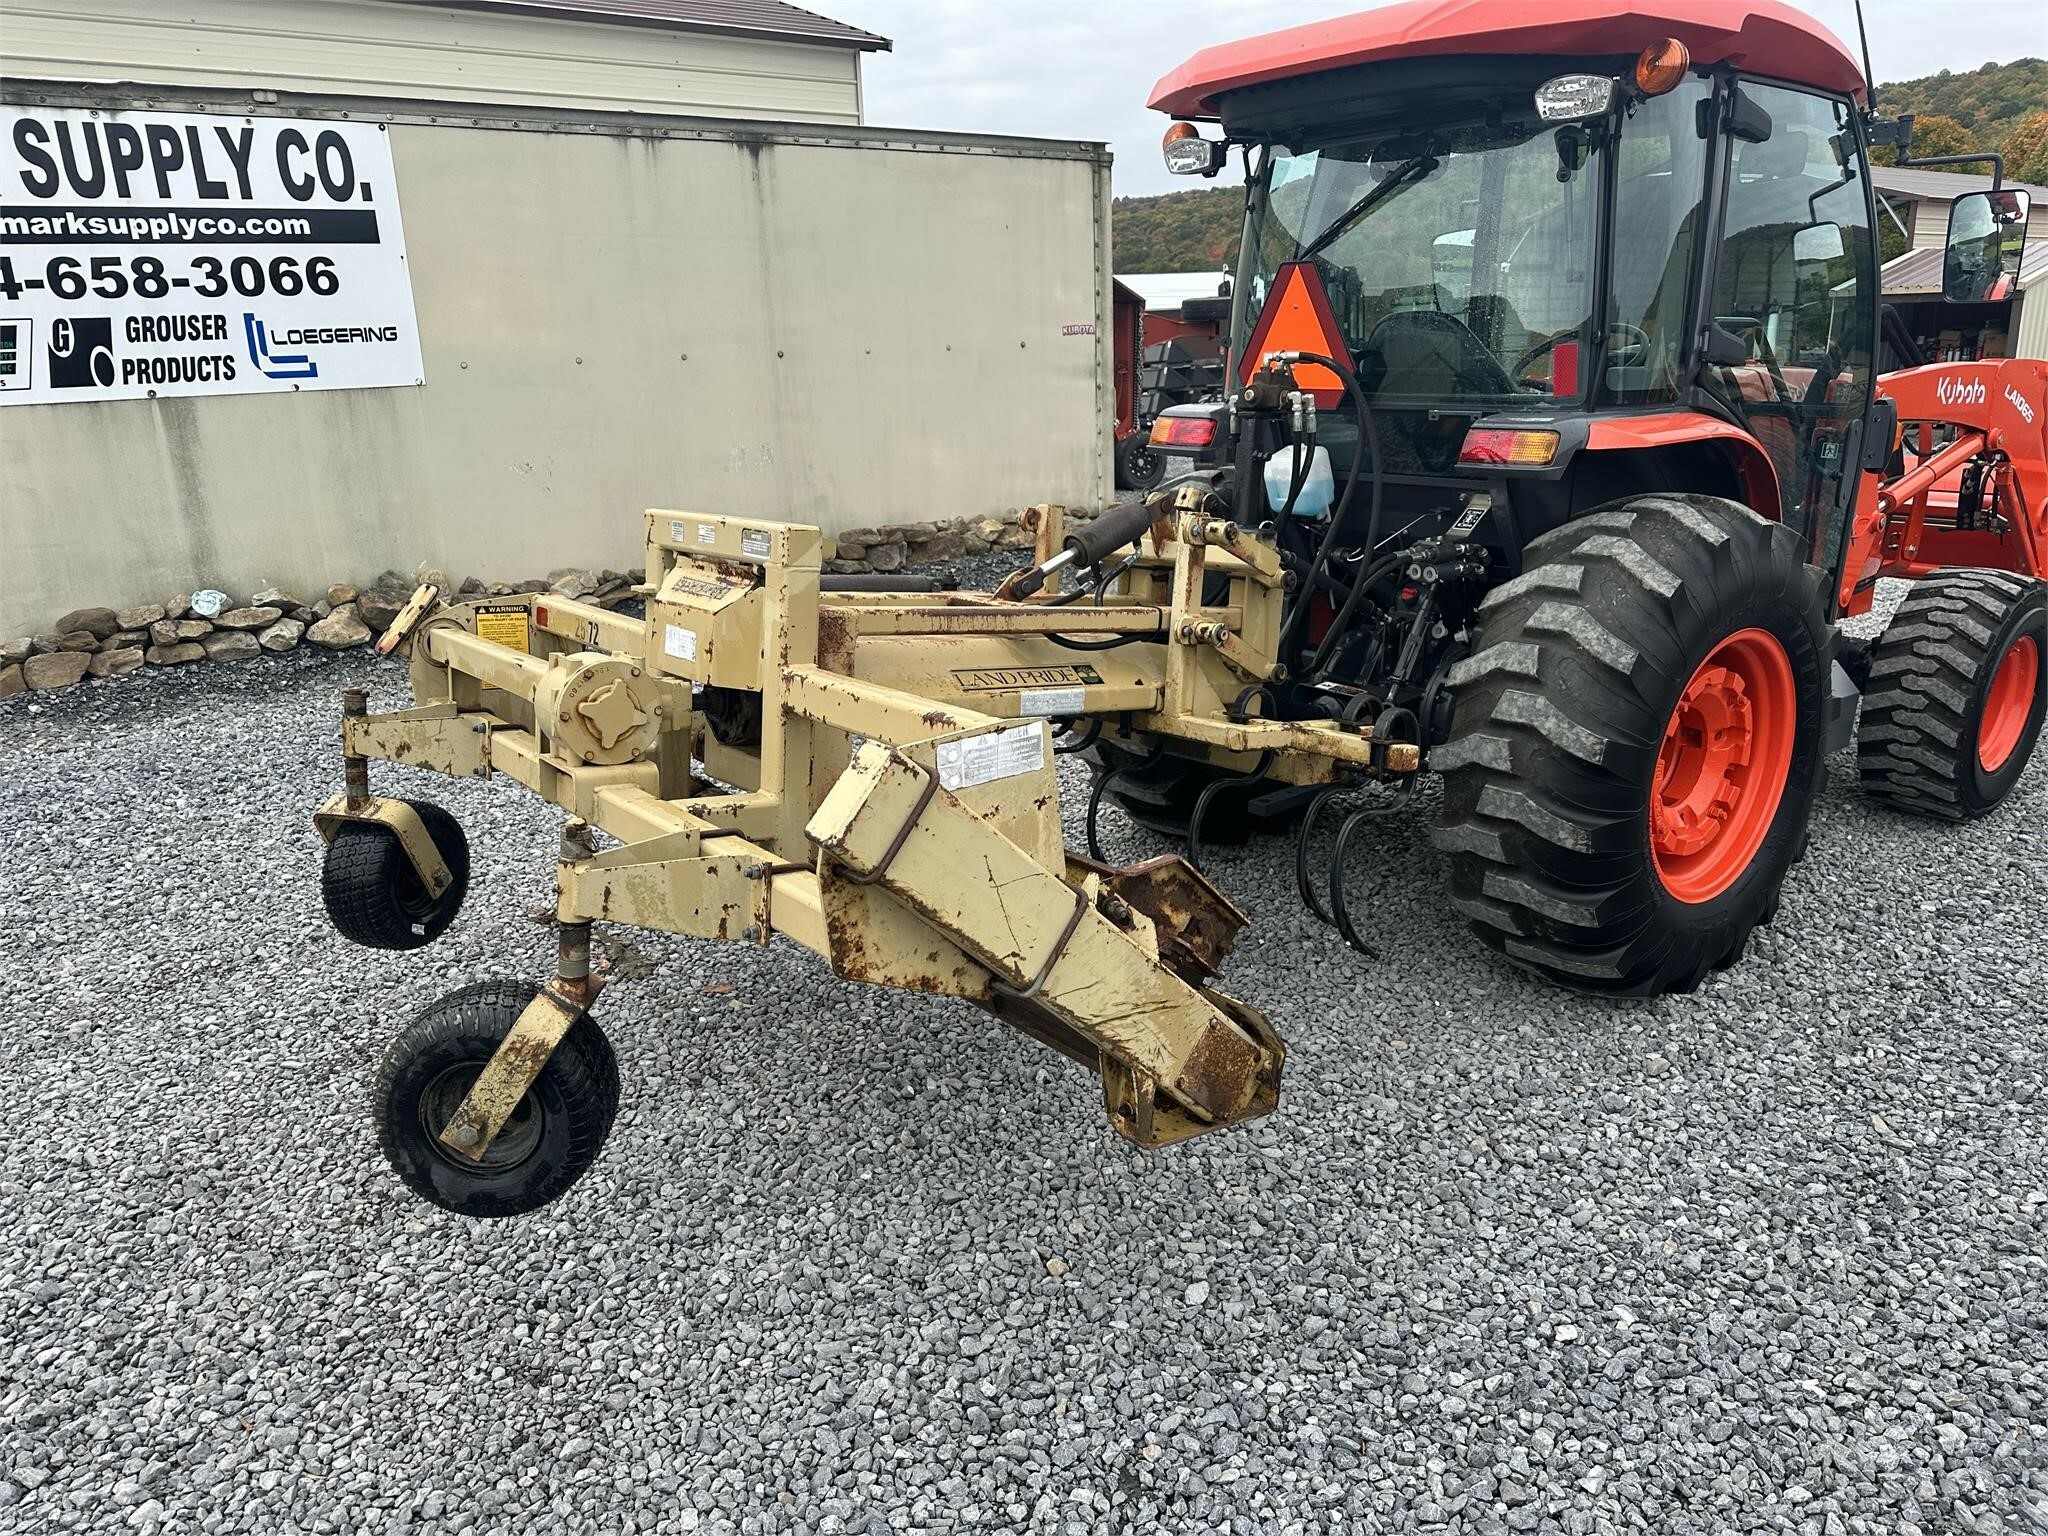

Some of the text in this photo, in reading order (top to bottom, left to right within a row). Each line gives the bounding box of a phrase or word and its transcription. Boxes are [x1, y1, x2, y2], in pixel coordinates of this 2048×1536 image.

[13, 118, 374, 203] SUPPLY CO.
[0, 255, 341, 301] 4-658-3066
[125, 314, 229, 345] GROUSER
[270, 326, 399, 346] LOEGERING
[1062, 325, 1095, 336] KUBOTA
[121, 354, 237, 385] PRODUCTS
[1936, 376, 1986, 405] Kubota
[2004, 383, 2035, 424] LA1065
[953, 668, 1080, 687] LAND PRIDE
